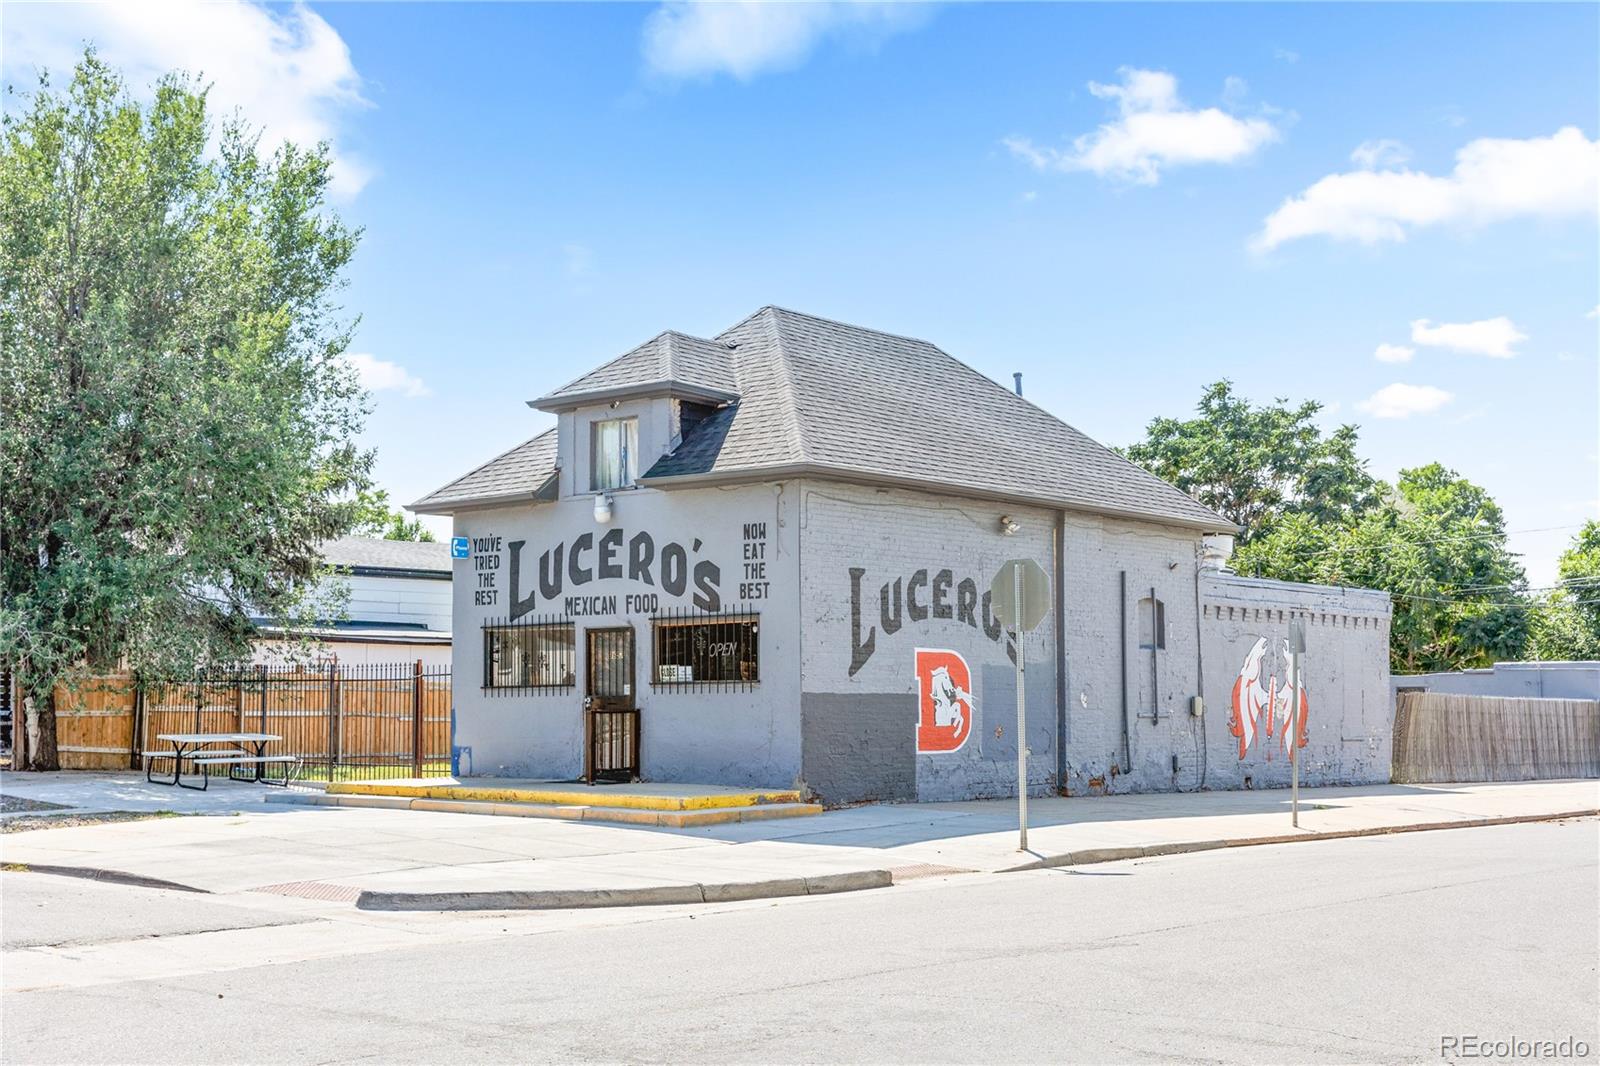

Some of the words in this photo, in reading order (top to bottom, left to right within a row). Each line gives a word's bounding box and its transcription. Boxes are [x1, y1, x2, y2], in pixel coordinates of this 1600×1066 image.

[744, 522, 766, 540] NOW
[473, 533, 502, 553] YOU'VE
[744, 543, 766, 560] EAT
[474, 555, 500, 571] TRIED
[744, 562, 766, 580] THE
[478, 573, 495, 588] THE
[508, 528, 721, 622] LUCERO'S
[475, 590, 498, 606] REST
[740, 582, 770, 600] BEST
[565, 595, 617, 617] MEXICAN
[625, 593, 659, 614] FOOD
[708, 641, 737, 658] OPEN
